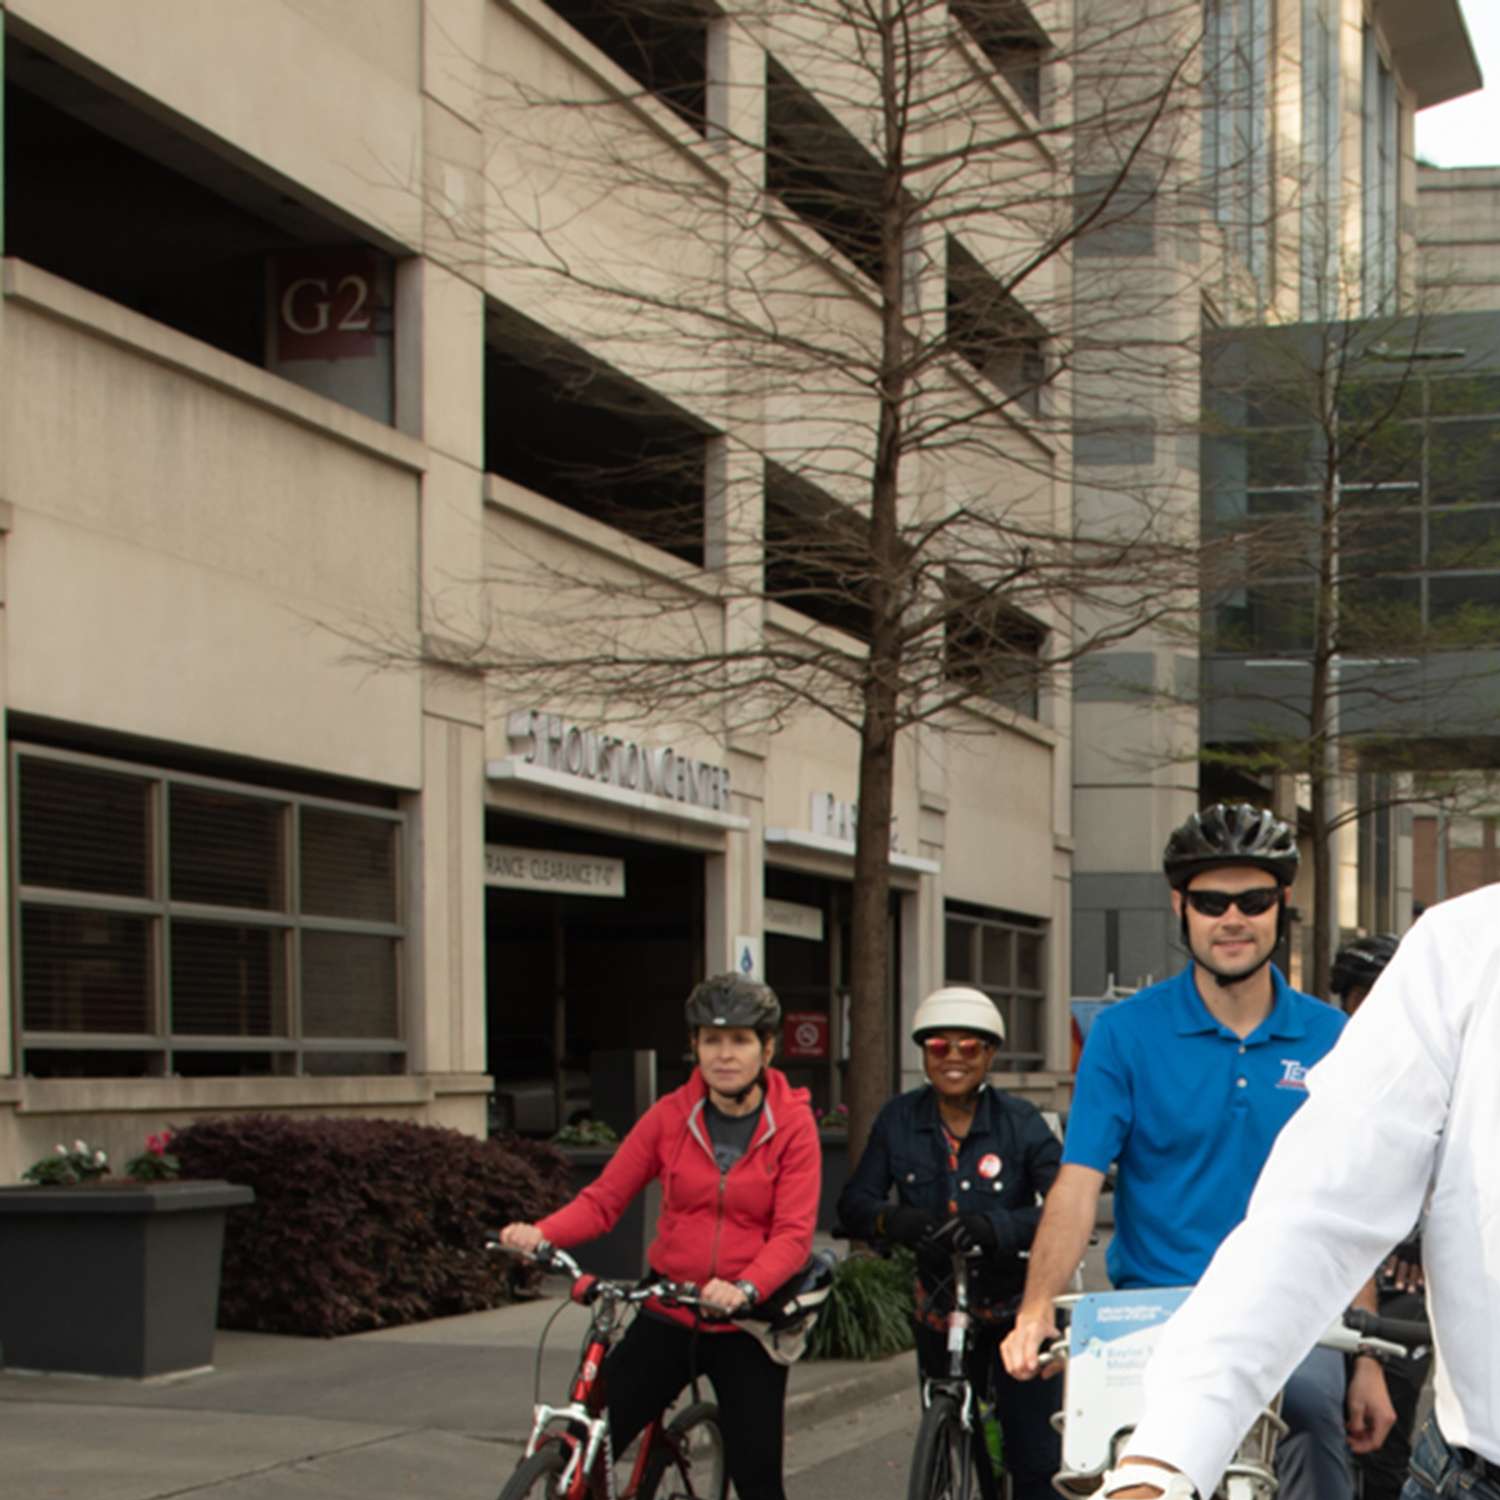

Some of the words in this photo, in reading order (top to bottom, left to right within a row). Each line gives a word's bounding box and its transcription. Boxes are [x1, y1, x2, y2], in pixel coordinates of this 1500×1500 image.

[282, 274, 370, 334] G2
[544, 712, 654, 794] HOUSTON
[656, 748, 731, 813] CENTER
[529, 858, 593, 886] CLEARANCE
